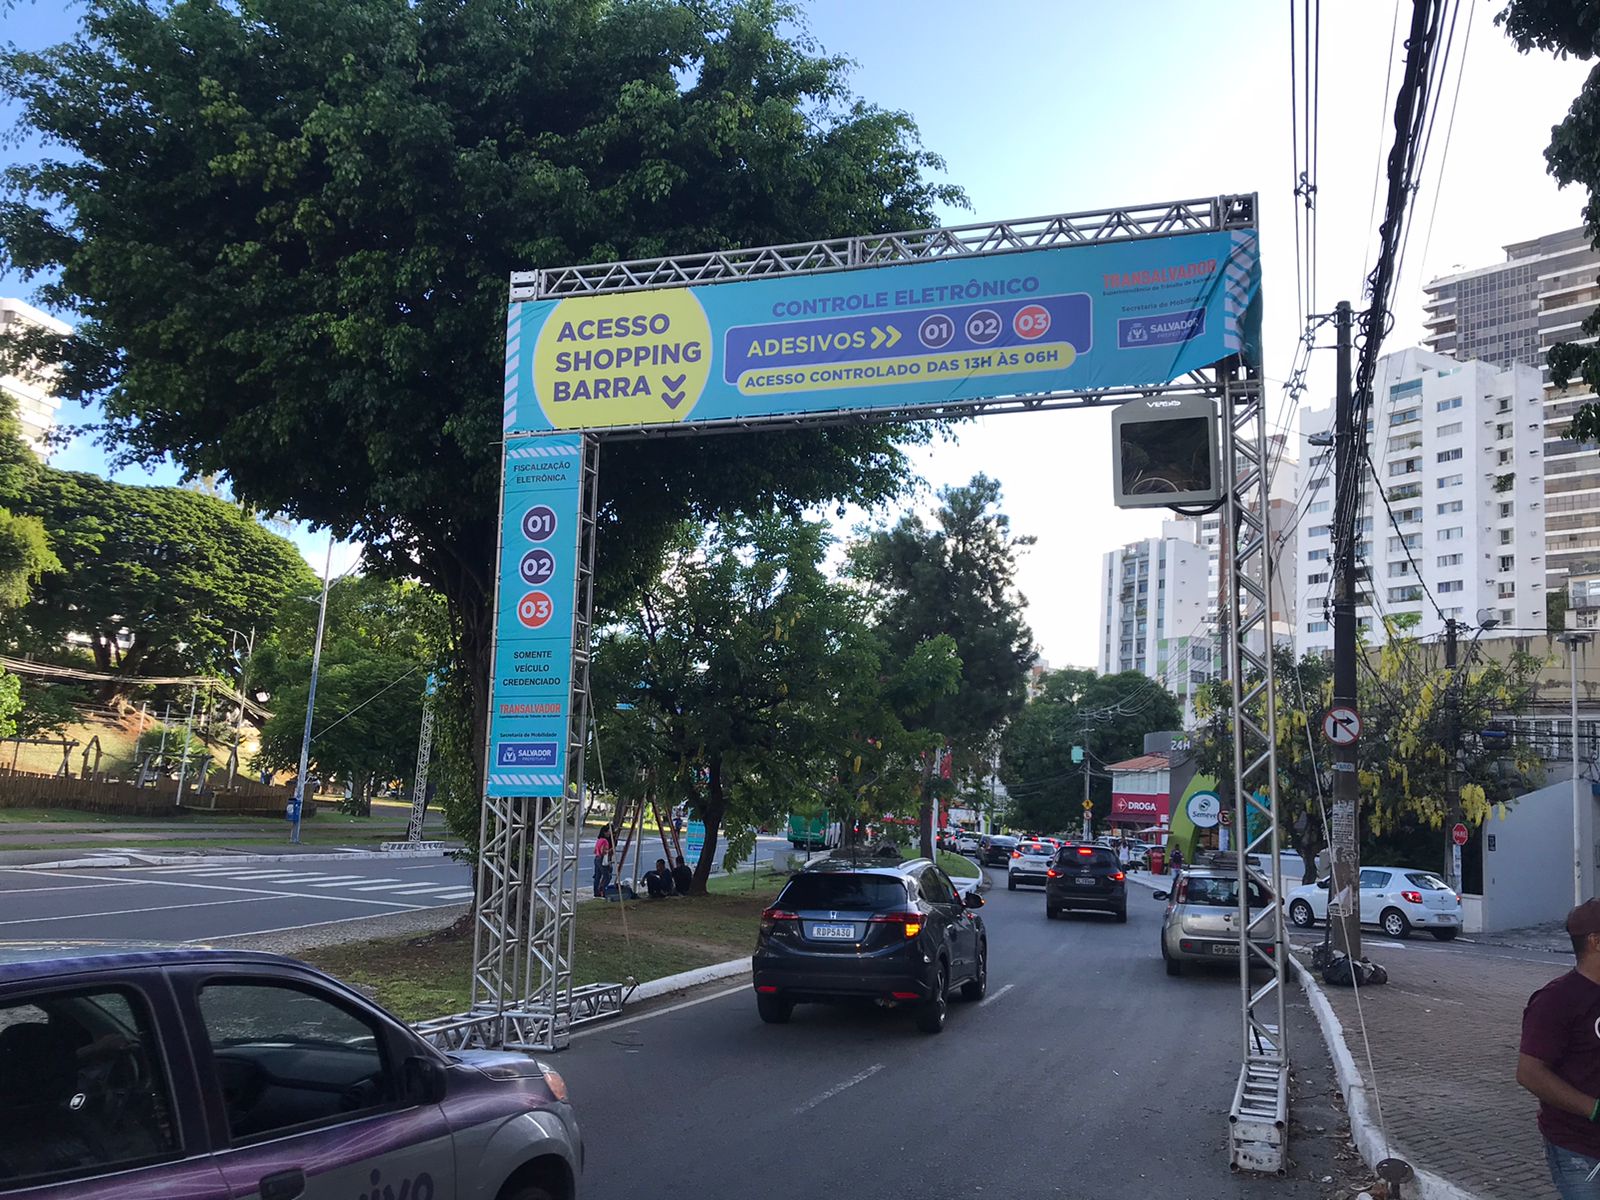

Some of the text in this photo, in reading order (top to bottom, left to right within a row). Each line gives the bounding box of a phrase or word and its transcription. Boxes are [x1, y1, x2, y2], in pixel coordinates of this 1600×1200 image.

[1103, 259, 1217, 289] TRANSALVADOR
[772, 276, 1040, 318] CONTROLE ELETRÔNICO
[557, 313, 671, 343] ACESSO
[924, 313, 1048, 341] 01 02 03
[747, 330, 866, 358] ADESIVOS
[555, 342, 702, 373] SHOPPING
[745, 348, 1059, 388] ACESSO CONTROLADO DAS 13H ÀS 06H
[553, 375, 651, 402] BARRA
[513, 461, 571, 472] FISCALIZAÇÃO
[516, 473, 567, 484] ELETRÔNICA
[527, 515, 551, 533] 01
[523, 558, 551, 576] 02
[521, 600, 549, 619] 03
[513, 650, 553, 659] SOMENTE
[514, 664, 550, 673] VEÍCULO
[502, 677, 561, 687] CREDENCIADO
[499, 703, 561, 714] TRANSALVADOR
[518, 749, 552, 757] SALVADOR
[1171, 739, 1191, 751] 24H
[1128, 801, 1157, 811] DROGA
